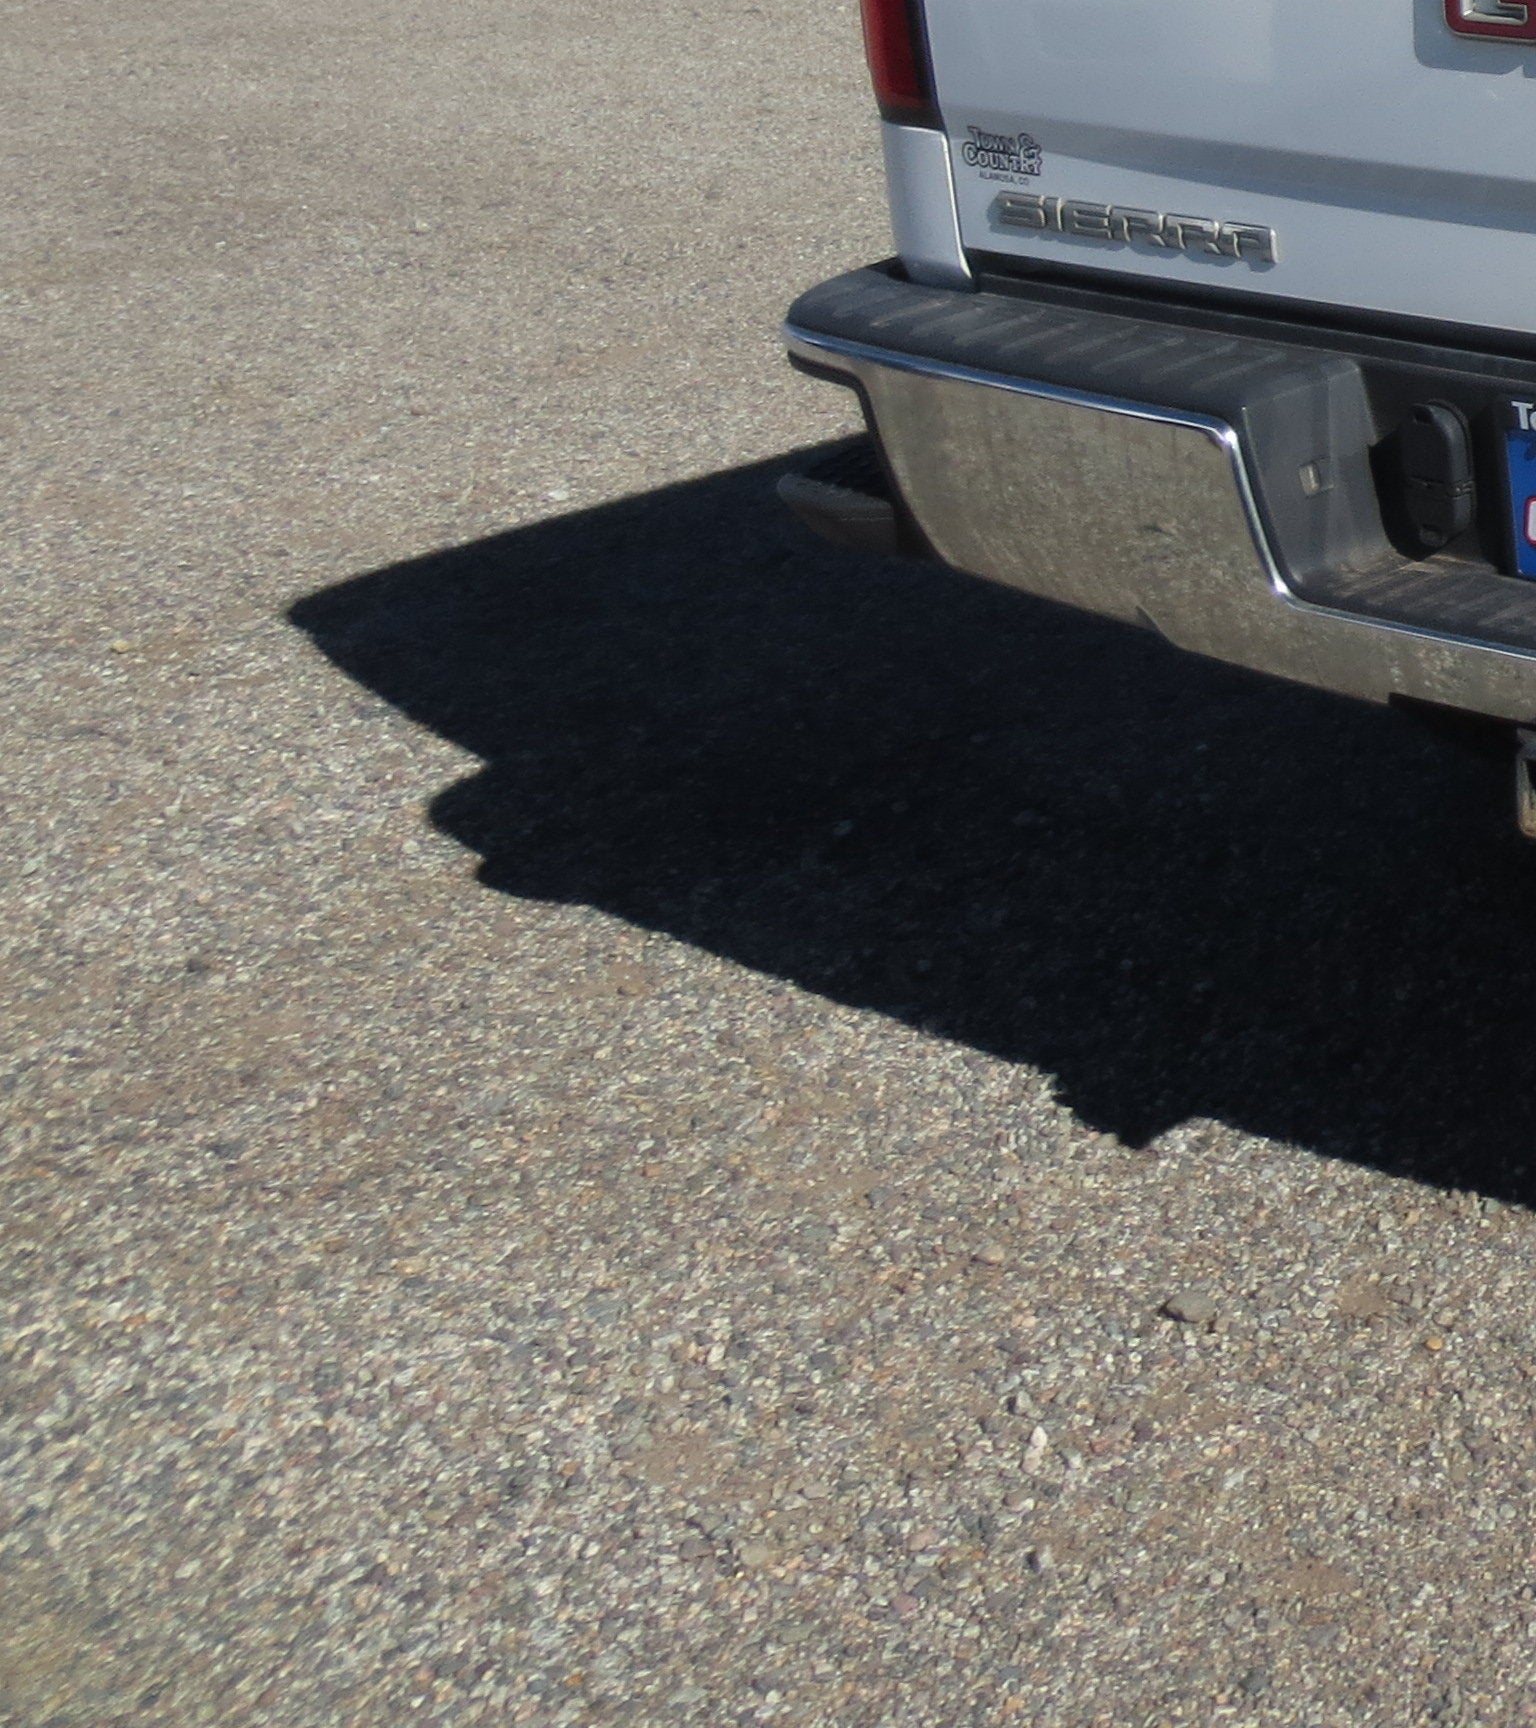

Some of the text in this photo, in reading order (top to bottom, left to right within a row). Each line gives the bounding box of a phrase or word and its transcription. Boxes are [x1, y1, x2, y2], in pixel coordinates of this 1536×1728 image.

[967, 125, 1018, 156] TOWN
[962, 141, 1042, 176] COUNTRY
[1000, 190, 1279, 264] SIERRA
